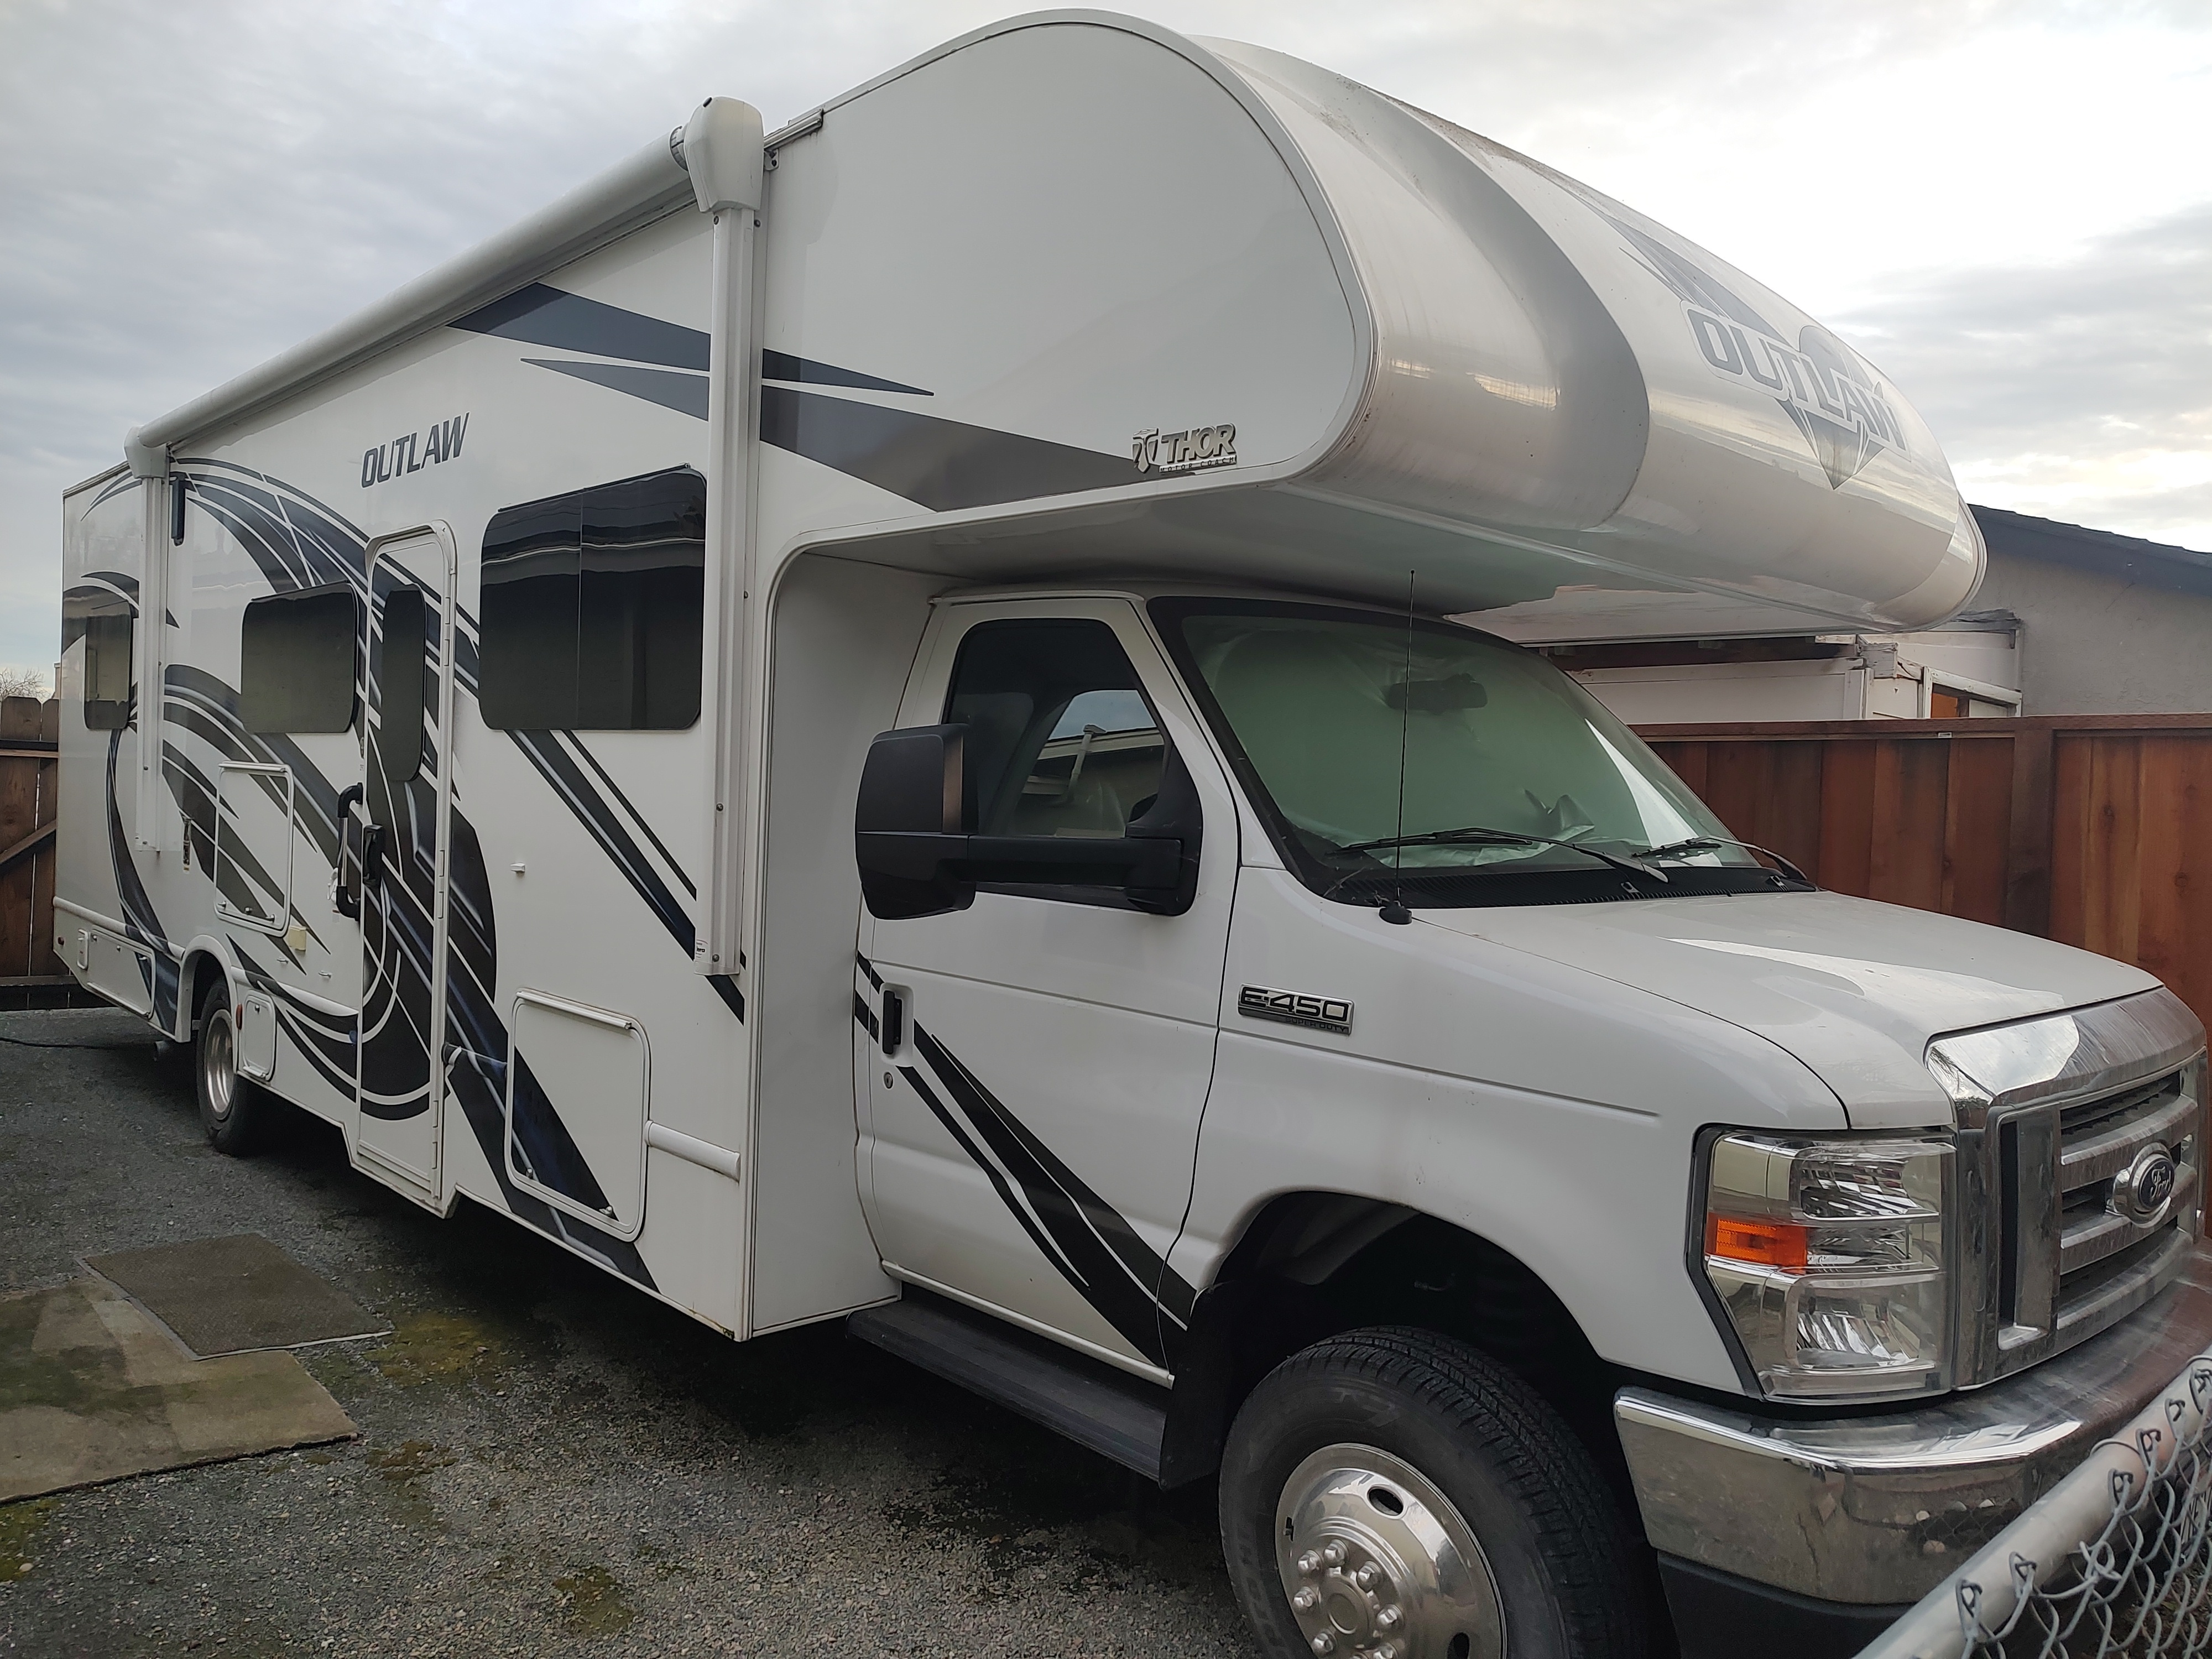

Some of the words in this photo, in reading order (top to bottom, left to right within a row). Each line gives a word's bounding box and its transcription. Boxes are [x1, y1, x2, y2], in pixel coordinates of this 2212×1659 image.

[1687, 307, 1907, 452] OUTLAW
[361, 411, 470, 488] OUTLAW
[1161, 422, 1237, 465] THOR
[1160, 463, 1193, 473] MOTOR
[1200, 456, 1234, 467] COACH
[1285, 1017, 1317, 1027] SUPER
[1319, 1023, 1347, 1032] DUTY
[2149, 1165, 2172, 1203] Ford
